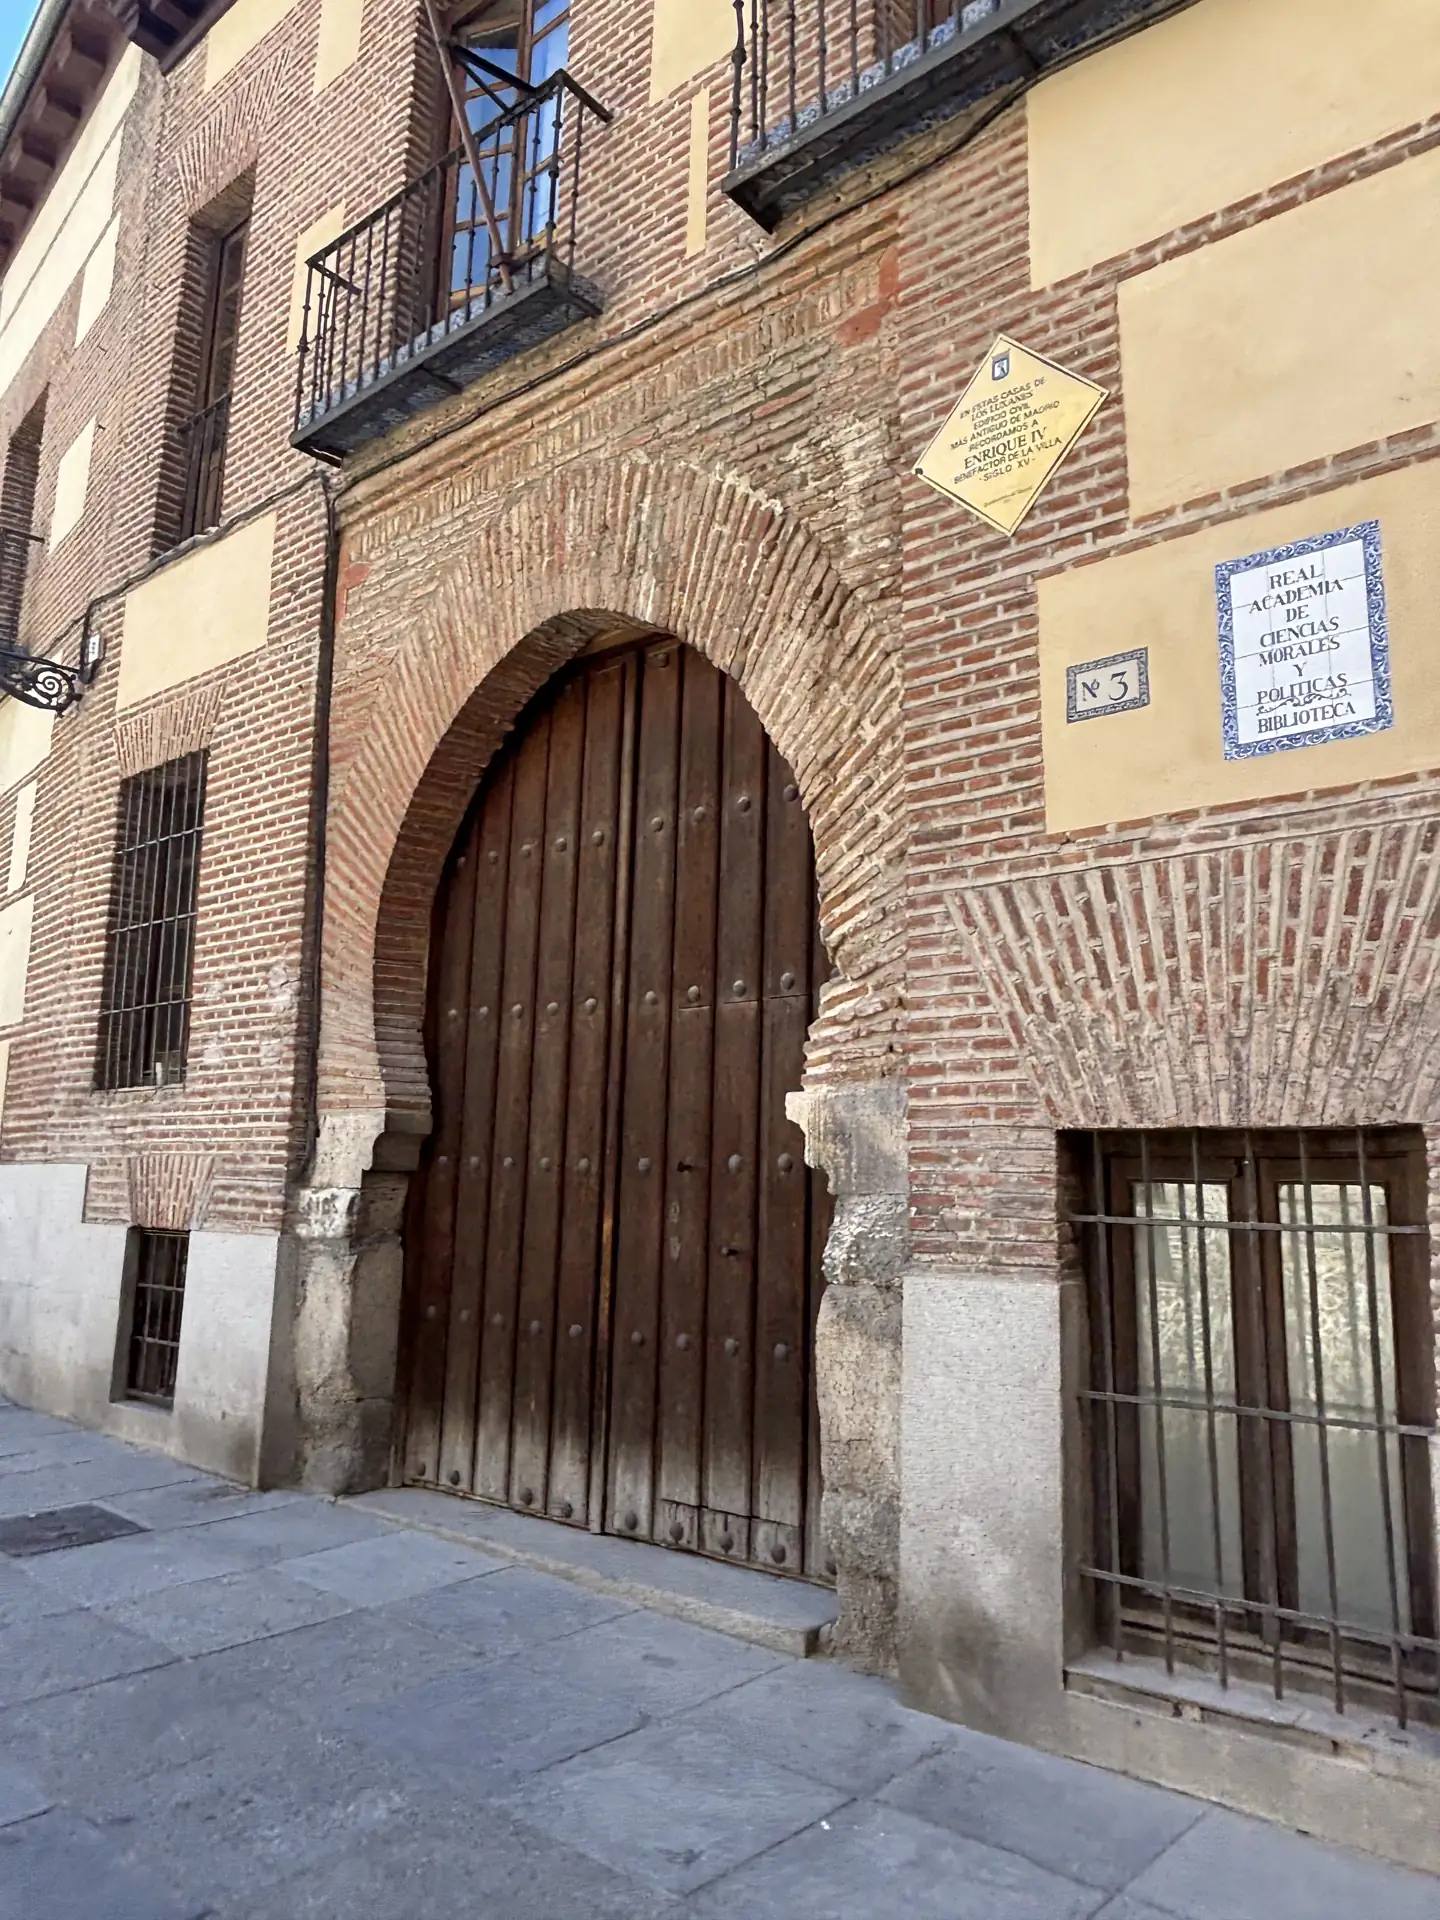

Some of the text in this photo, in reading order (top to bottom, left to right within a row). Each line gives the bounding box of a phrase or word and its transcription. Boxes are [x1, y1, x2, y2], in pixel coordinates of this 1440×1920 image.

[972, 395, 999, 412] ESTAS
[1000, 383, 1031, 400] CASAS
[1034, 376, 1045, 388] DE
[970, 420, 1008, 442] ANTIGUO
[1010, 414, 1021, 424] DE
[1024, 400, 1060, 420] MADRID
[972, 408, 988, 421] LOS
[964, 426, 1047, 470] ENRIQUE IV
[968, 419, 1038, 452] RECORDAMOS A
[954, 437, 1062, 484] BENEFACTOR DE LA VILLA
[1270, 564, 1324, 590] REAL
[1249, 580, 1344, 614] ACADEMIA
[1286, 604, 1310, 622] DE
[1260, 616, 1340, 648] CIENCIAS
[1259, 636, 1340, 667] MORALES
[1292, 661, 1307, 676] Y
[1108, 671, 1128, 701] 3
[1257, 672, 1348, 704] POLITICAS
[1258, 702, 1356, 734] BIBLIOTECA
